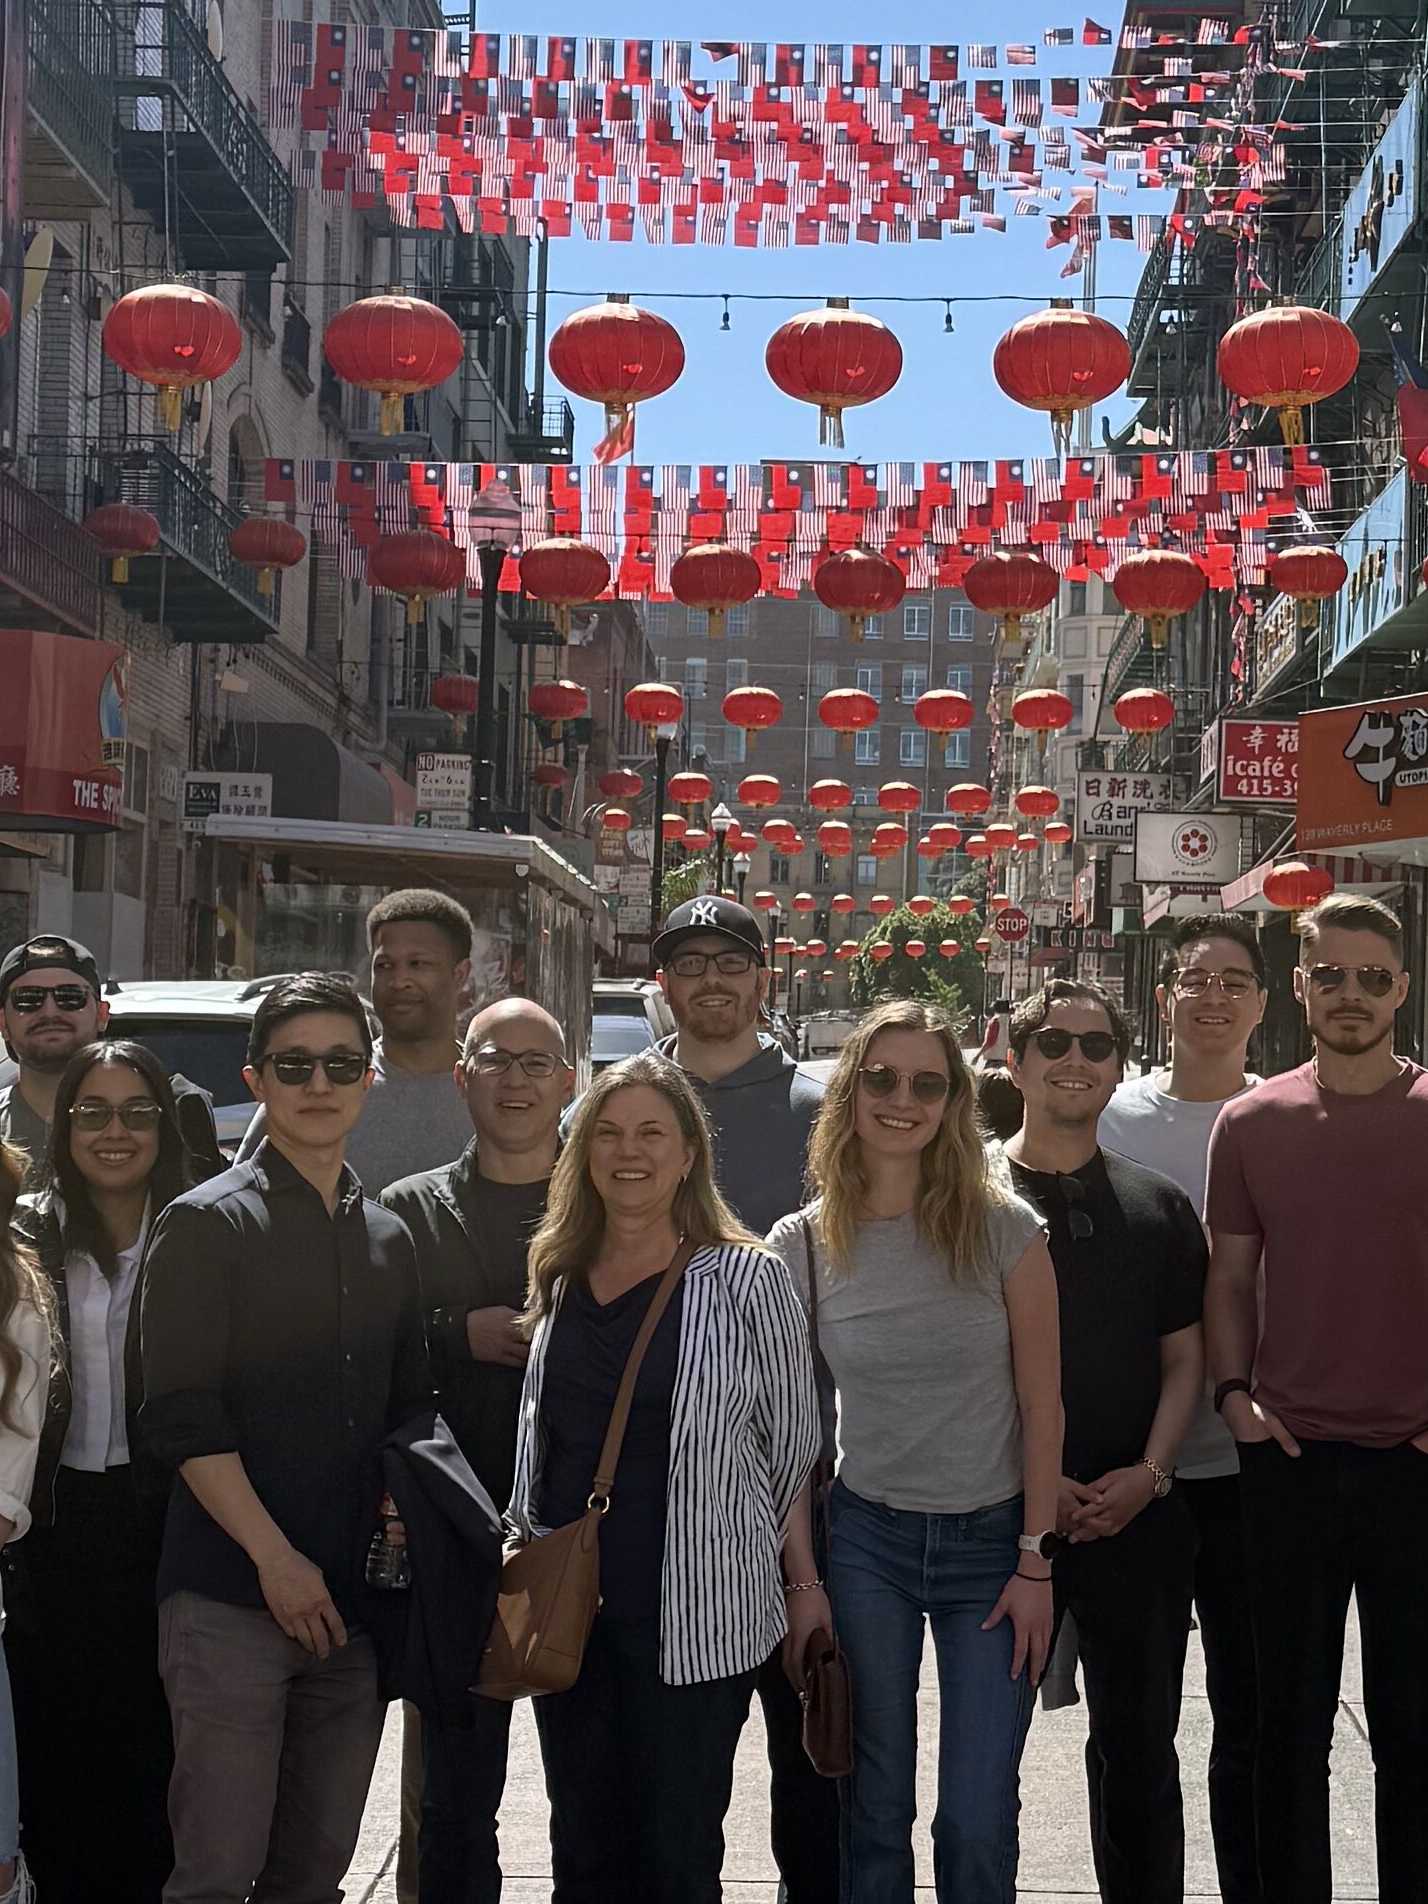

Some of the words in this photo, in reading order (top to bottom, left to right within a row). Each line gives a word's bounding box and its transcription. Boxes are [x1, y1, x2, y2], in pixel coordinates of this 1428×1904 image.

[72, 779, 99, 810] THE
[1237, 778, 1299, 796] 415-3
[1084, 819, 1134, 837] Laund
[997, 918, 1027, 932] STOP
